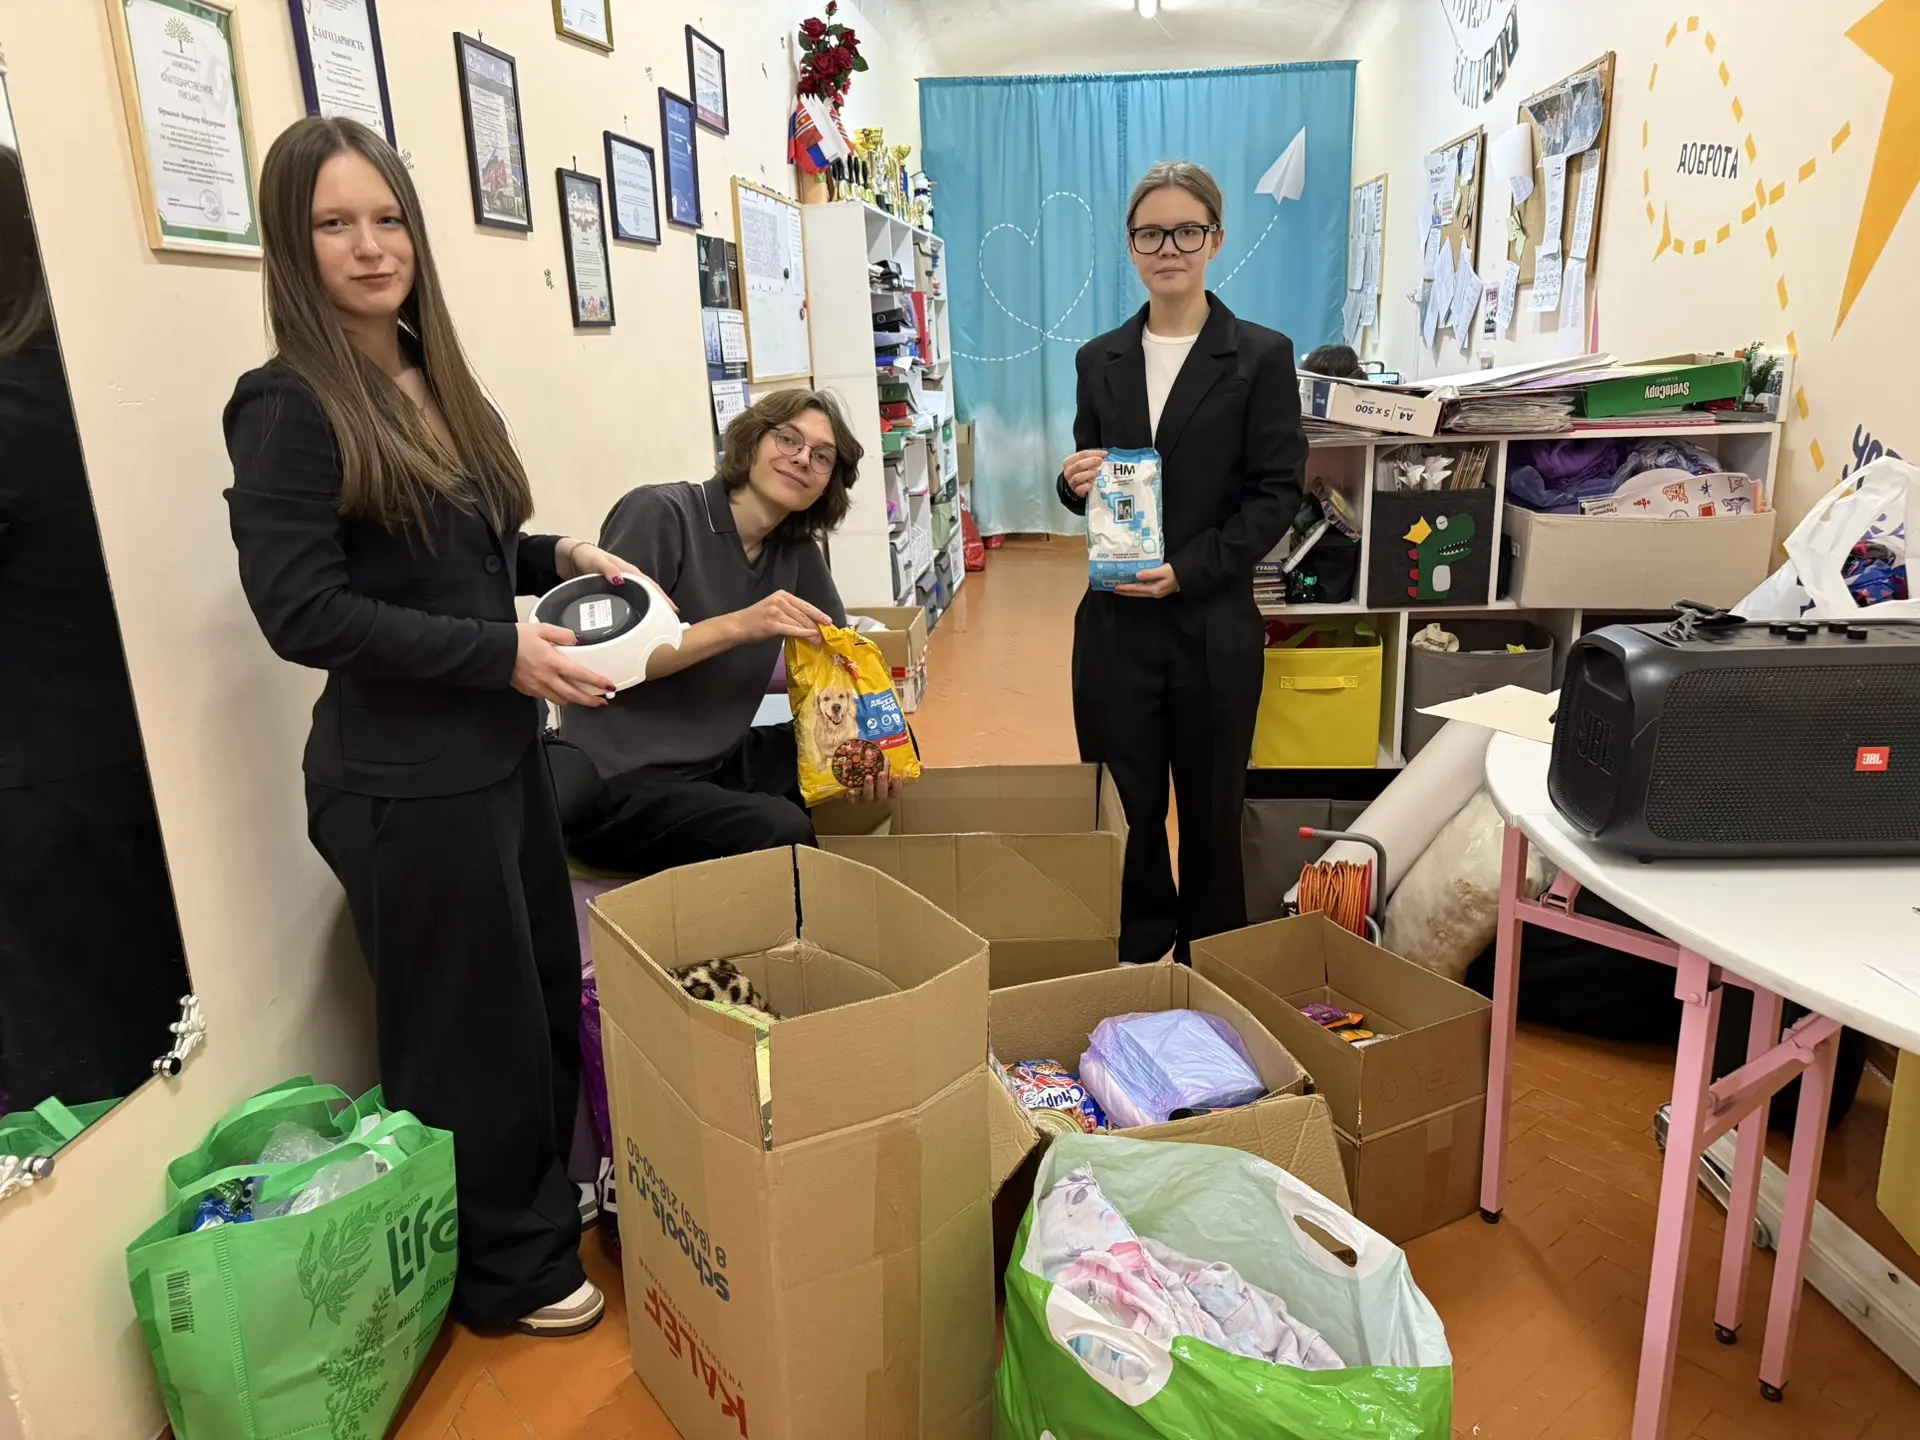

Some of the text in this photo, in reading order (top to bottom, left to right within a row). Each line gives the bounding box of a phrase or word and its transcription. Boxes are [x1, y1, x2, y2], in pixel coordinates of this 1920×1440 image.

[1676, 142, 1739, 180] ДОБРОТА
[1644, 381, 1690, 399] SvetoCopy
[1355, 404, 1375, 415] 500
[1383, 409, 1391, 418] 5
[1399, 411, 1414, 422] A4
[1862, 753, 1883, 765] JBL
[628, 1160, 731, 1302] schools.ru
[680, 1202, 711, 1257] (843)
[714, 1246, 727, 1269] 8
